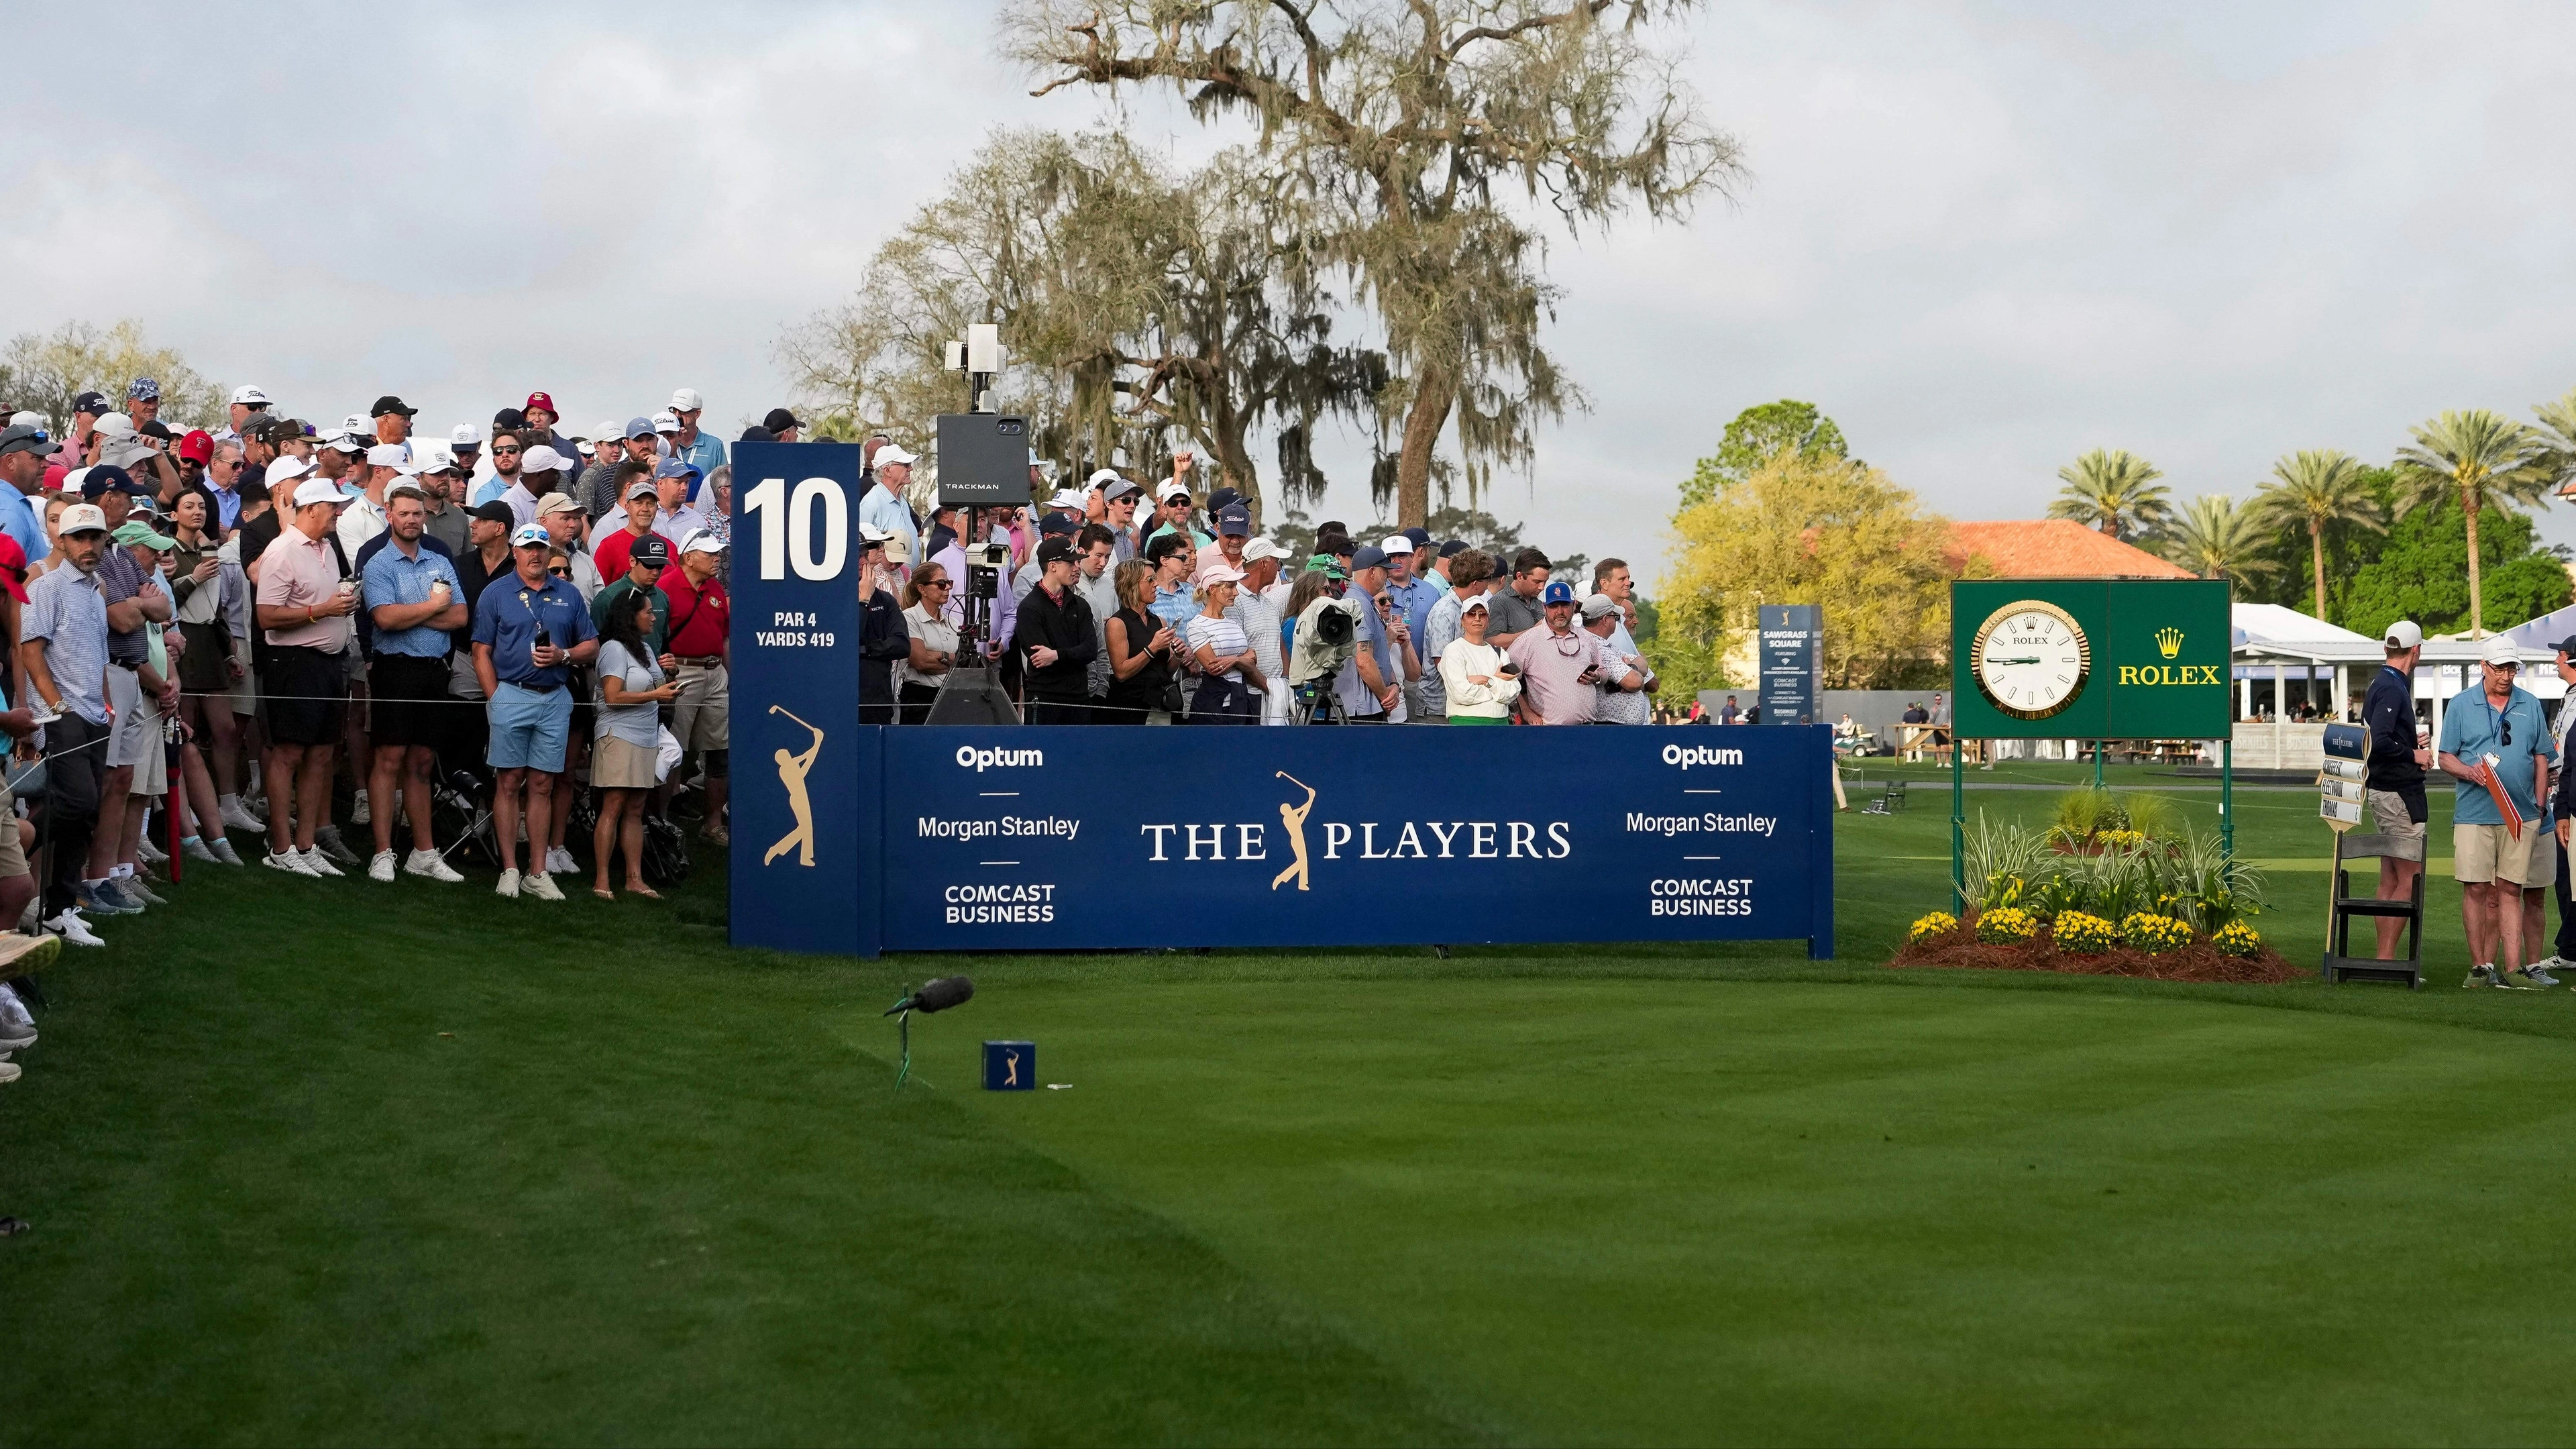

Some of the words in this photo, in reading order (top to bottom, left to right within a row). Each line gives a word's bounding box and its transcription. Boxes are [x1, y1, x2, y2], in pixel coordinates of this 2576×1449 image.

[744, 477, 848, 581] 10
[775, 612, 804, 627] PAR
[808, 612, 816, 627] 4
[756, 632, 806, 646] YARDS
[810, 633, 835, 647] 419
[1763, 631, 1808, 639] SAWGRASS
[2118, 665, 2221, 686] ROLEX
[2233, 735, 2268, 749] USHMILLS
[956, 745, 1043, 772] Optum
[1662, 744, 1743, 769] Optum
[918, 817, 997, 842] Morgan
[1002, 816, 1080, 841] Stanley
[1627, 812, 1699, 837] Morgan
[1703, 812, 1777, 837] Stanley
[1140, 823, 1267, 861] THE
[1322, 822, 1571, 859] PLAYERS
[945, 884, 1055, 903] COMCAST
[1650, 879, 1753, 896] COMCAST
[947, 905, 1054, 924] BUSINESS
[1652, 899, 1752, 916] BUSINESS
